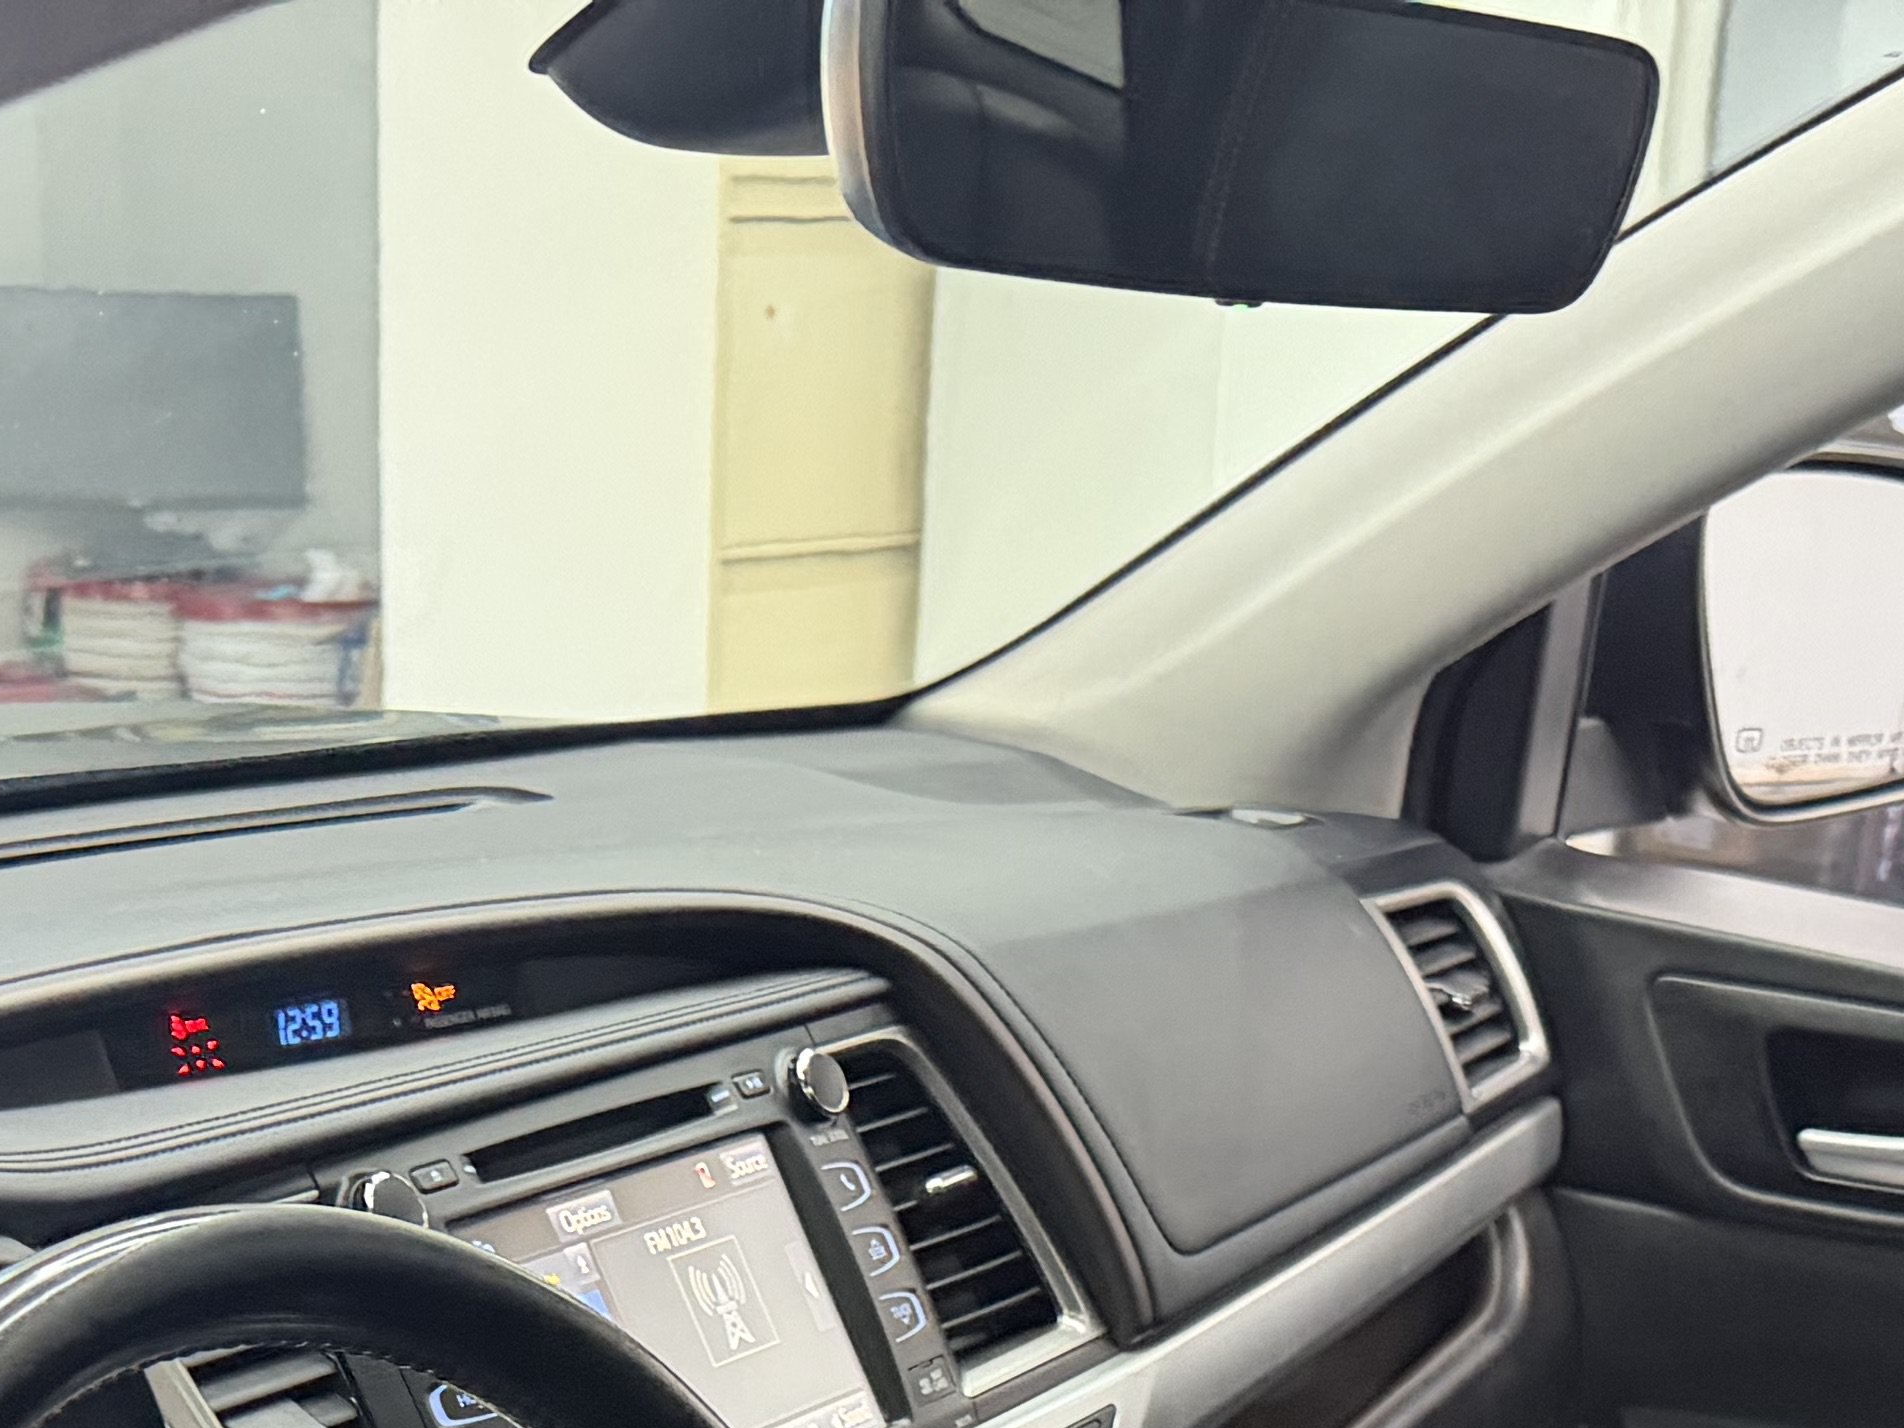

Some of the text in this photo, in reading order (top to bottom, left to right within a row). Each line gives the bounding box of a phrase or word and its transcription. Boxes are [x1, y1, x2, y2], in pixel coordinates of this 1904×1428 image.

[276, 999, 342, 1047] 12:59
[721, 1149, 771, 1181] Source
[558, 1201, 613, 1236] Options
